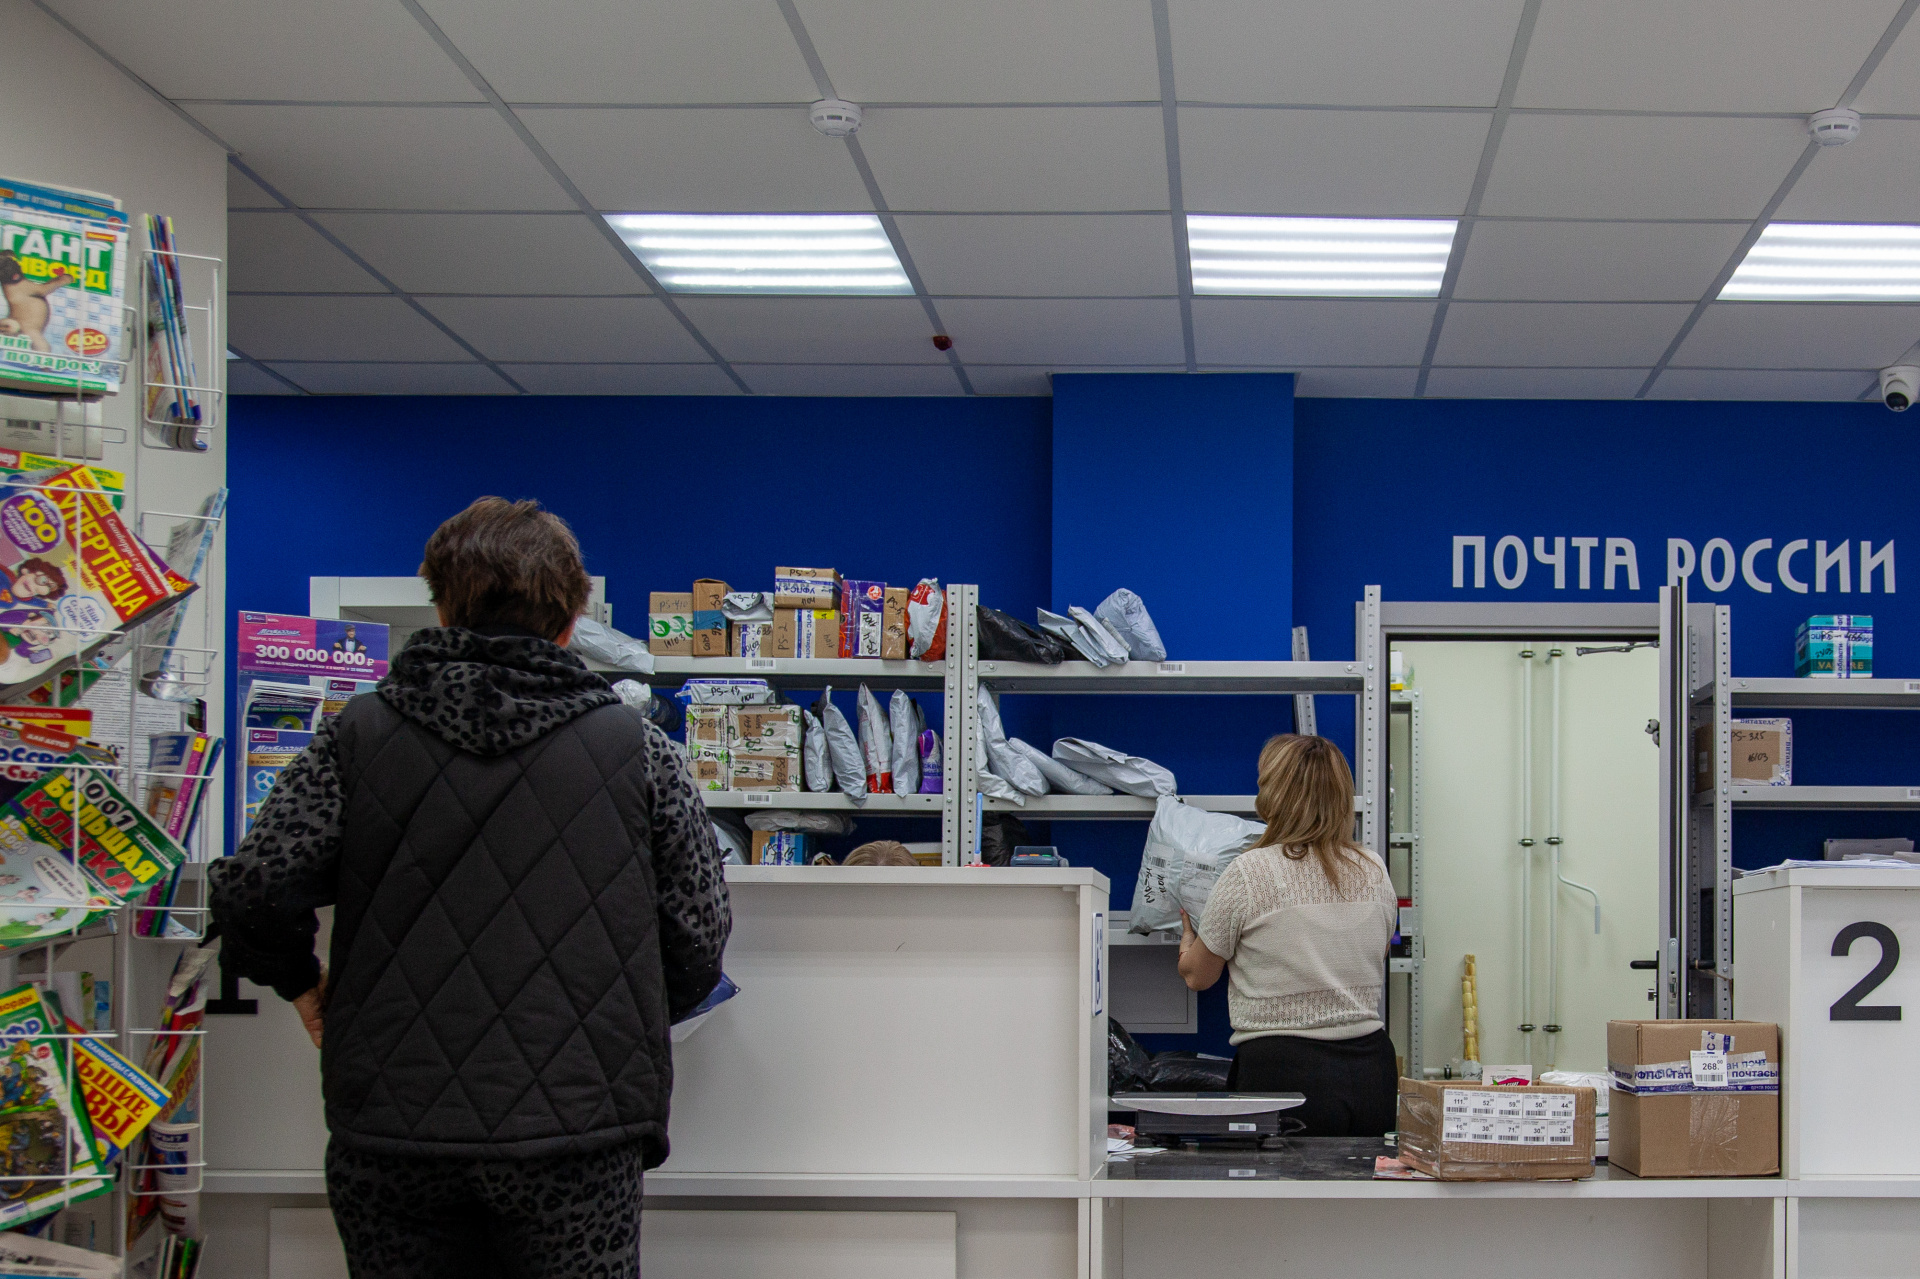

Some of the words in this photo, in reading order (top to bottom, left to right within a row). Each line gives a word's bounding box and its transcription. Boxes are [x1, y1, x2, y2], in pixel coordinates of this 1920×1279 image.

[6, 351, 100, 374] подарок!
[18, 499, 57, 543] 100
[105, 517, 136, 560] Сканворды
[43, 478, 148, 616] СУПЕРТЁЩА
[1452, 535, 1640, 589] ПОЧТА
[1667, 537, 1896, 593] РОССИИ
[255, 645, 290, 659] 300
[294, 647, 328, 662] 000
[333, 651, 366, 665] 000
[21, 789, 135, 897] КЛЕТКА
[44, 774, 160, 884] БОЛЬШАЯ
[1830, 921, 1902, 1021] 2
[82, 1038, 126, 1073] СКАНВОРДЫ
[1732, 1069, 1778, 1079] почтасы
